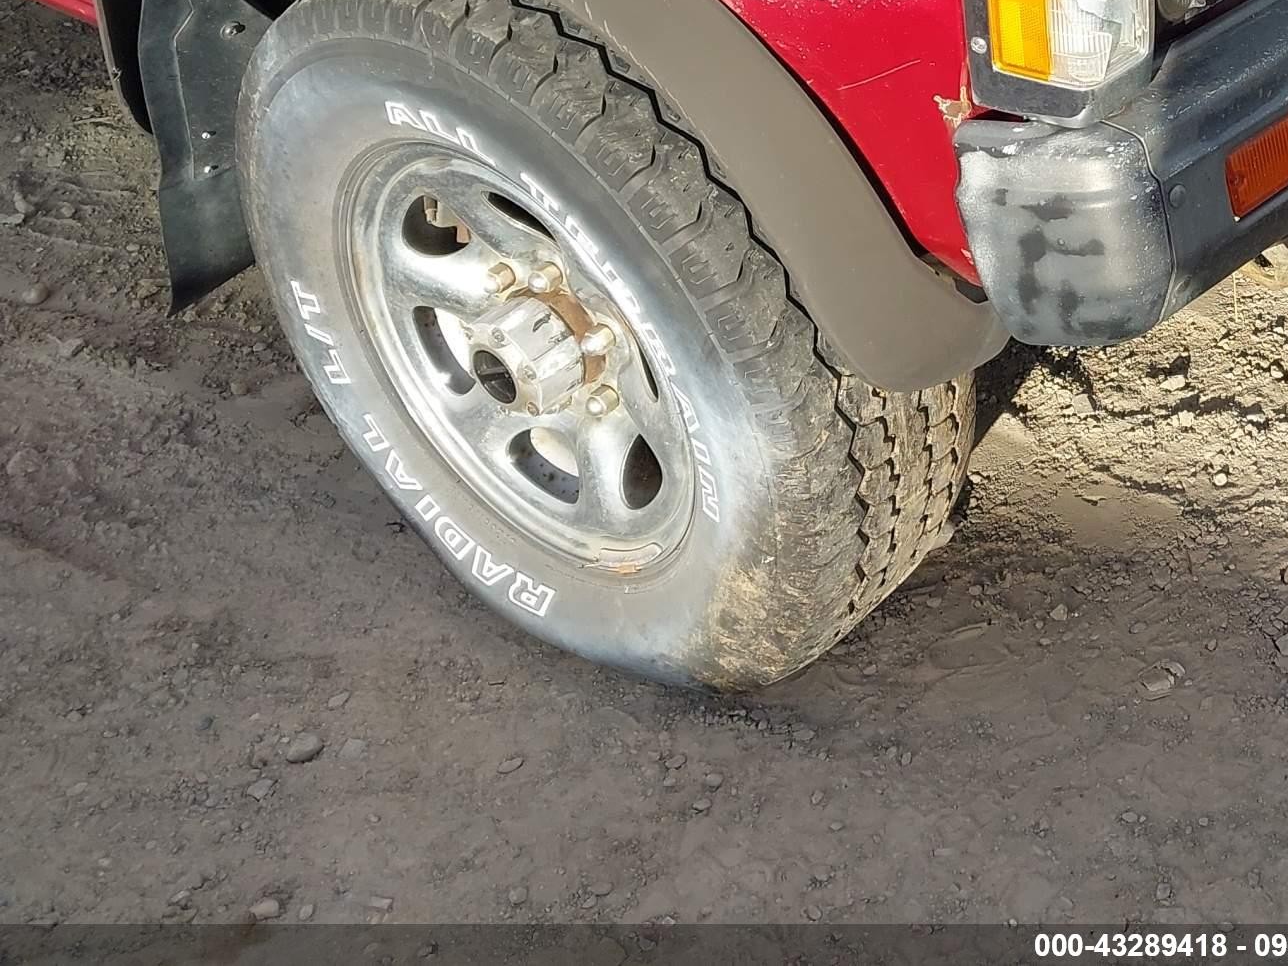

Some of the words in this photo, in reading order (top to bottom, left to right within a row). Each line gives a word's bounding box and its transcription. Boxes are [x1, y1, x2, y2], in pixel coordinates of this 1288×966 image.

[290, 280, 352, 384] L/T
[384, 100, 497, 168] ALL
[519, 171, 720, 523] TERRAIN
[362, 413, 557, 617] RADIAL
